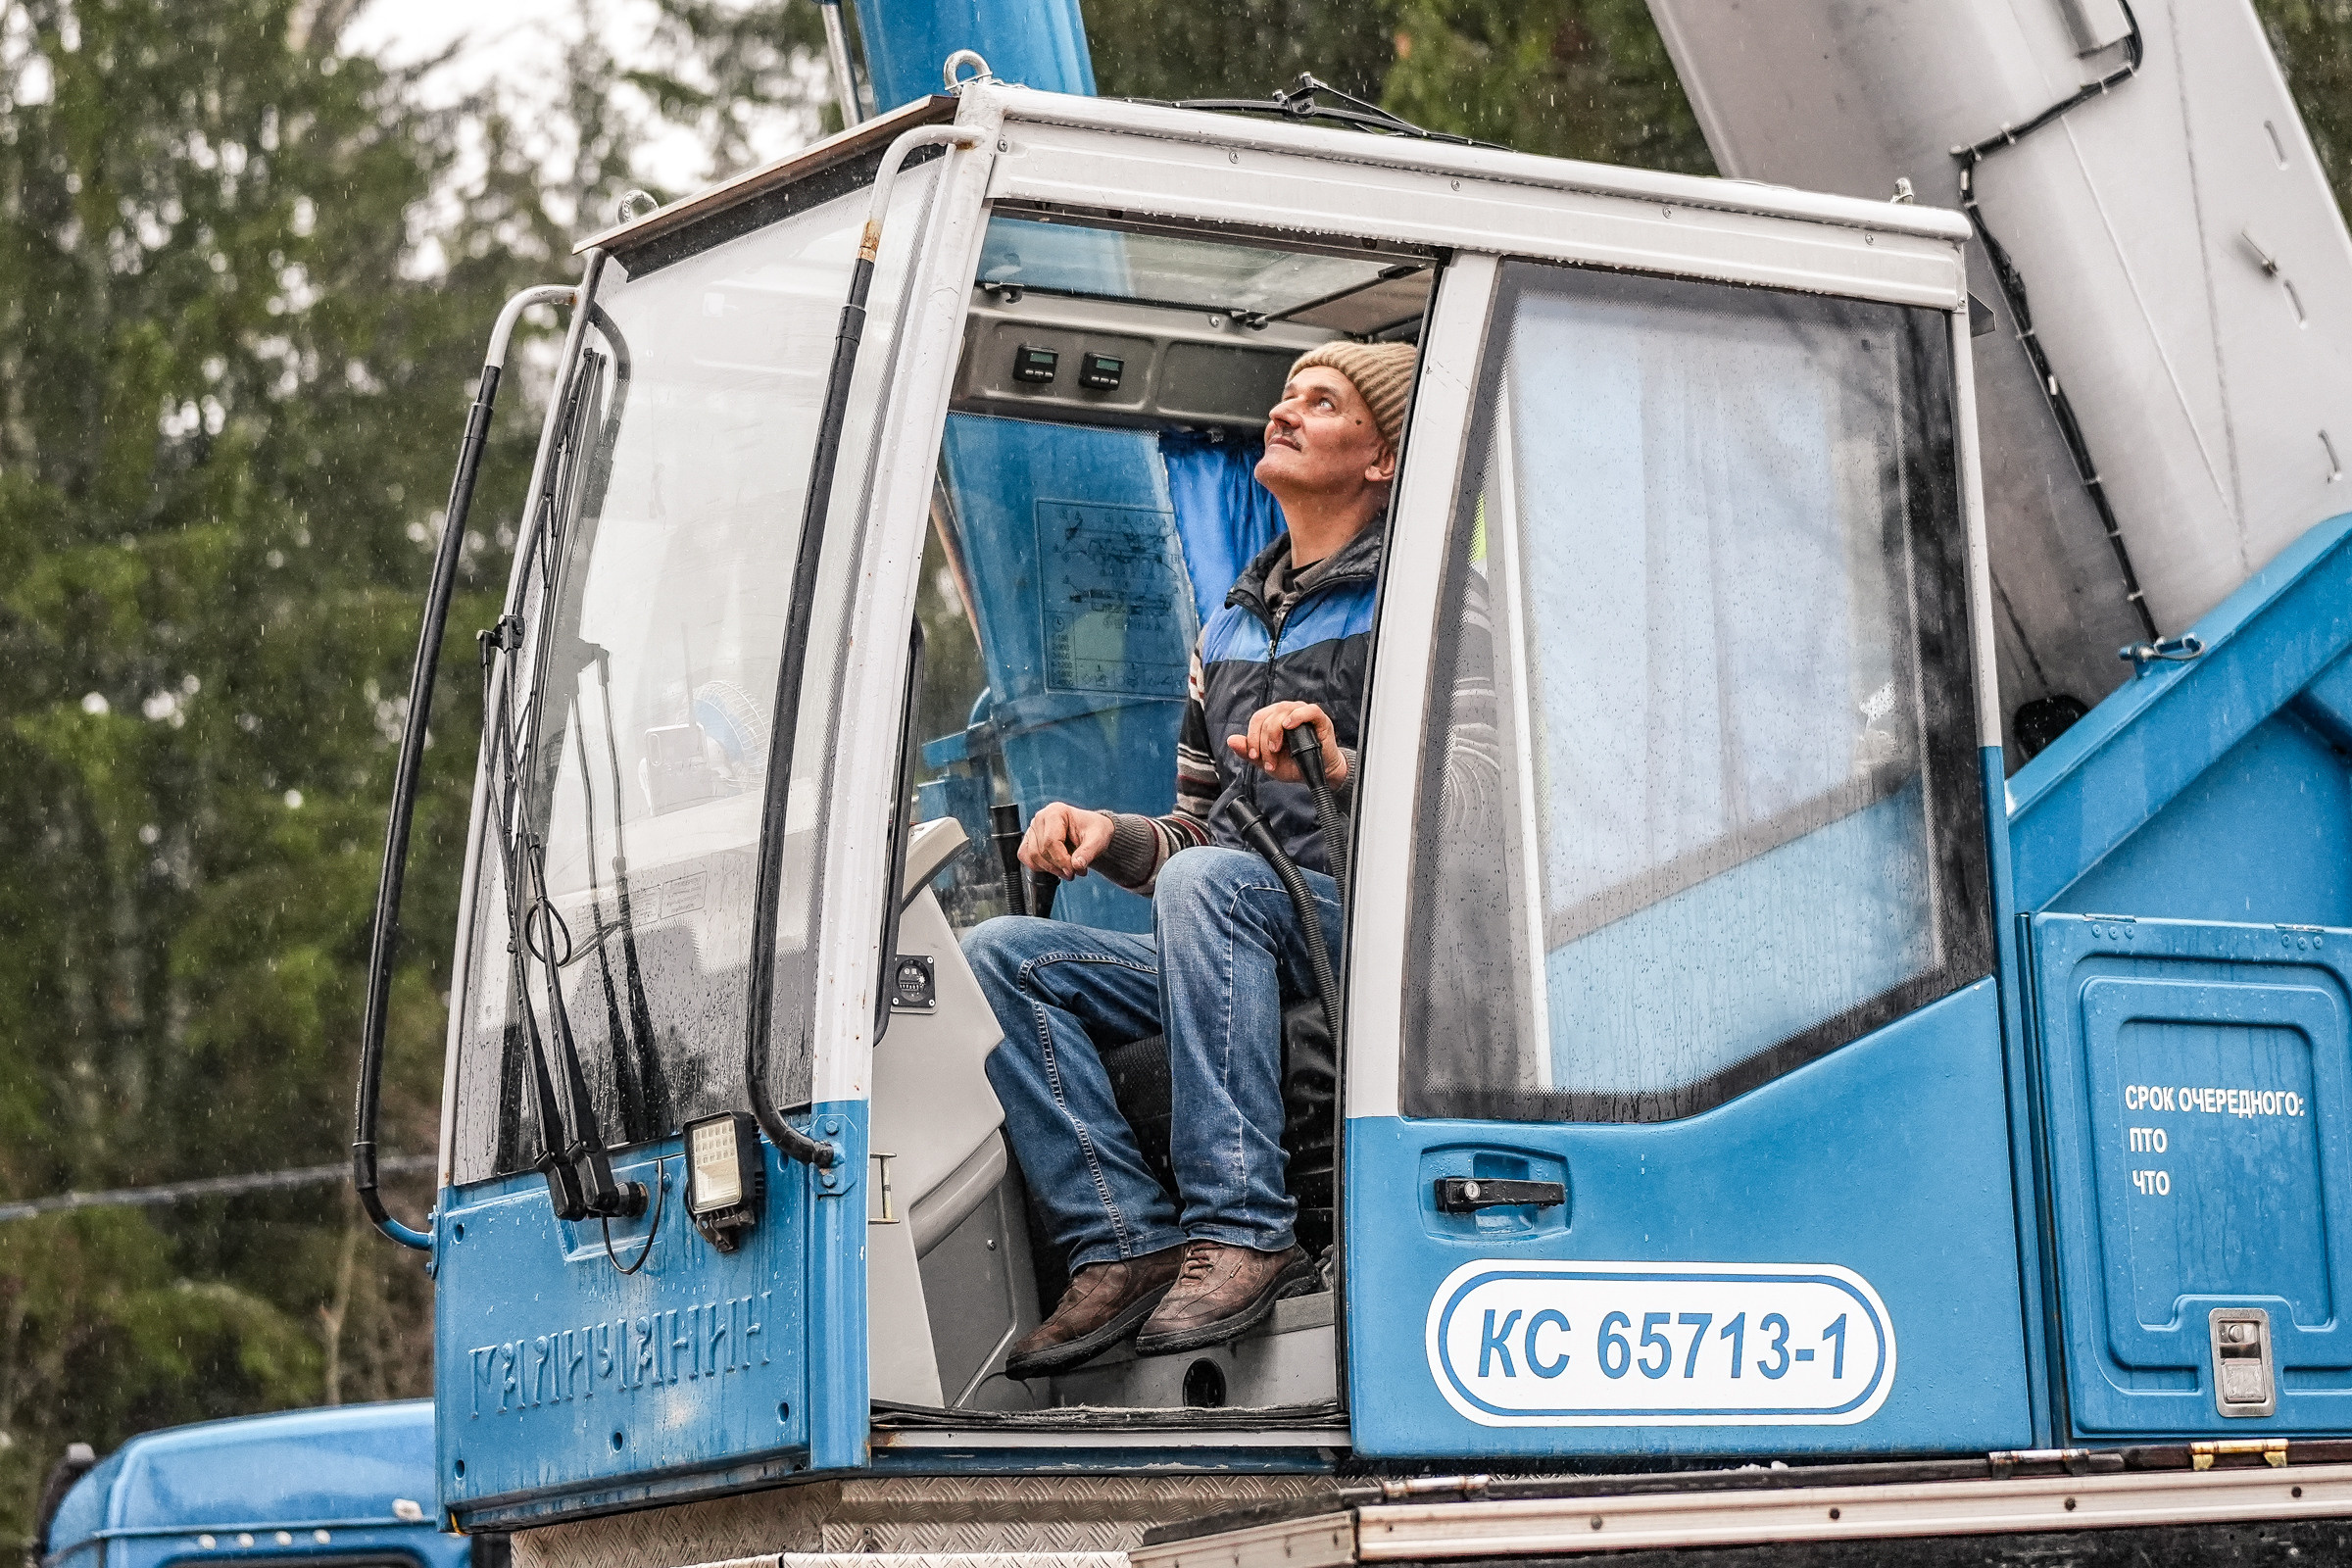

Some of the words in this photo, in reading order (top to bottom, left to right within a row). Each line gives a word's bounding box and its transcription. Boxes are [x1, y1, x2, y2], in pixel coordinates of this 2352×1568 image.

[2125, 1085, 2176, 1111] СРОК
[2179, 1087, 2305, 1119] ОЧЕРЕДНОГО:
[2129, 1127, 2168, 1153] ПТО
[2132, 1169, 2171, 1197] ЧТО
[1477, 1308, 1571, 1379] КС
[1597, 1310, 1847, 1380] 65713-1
